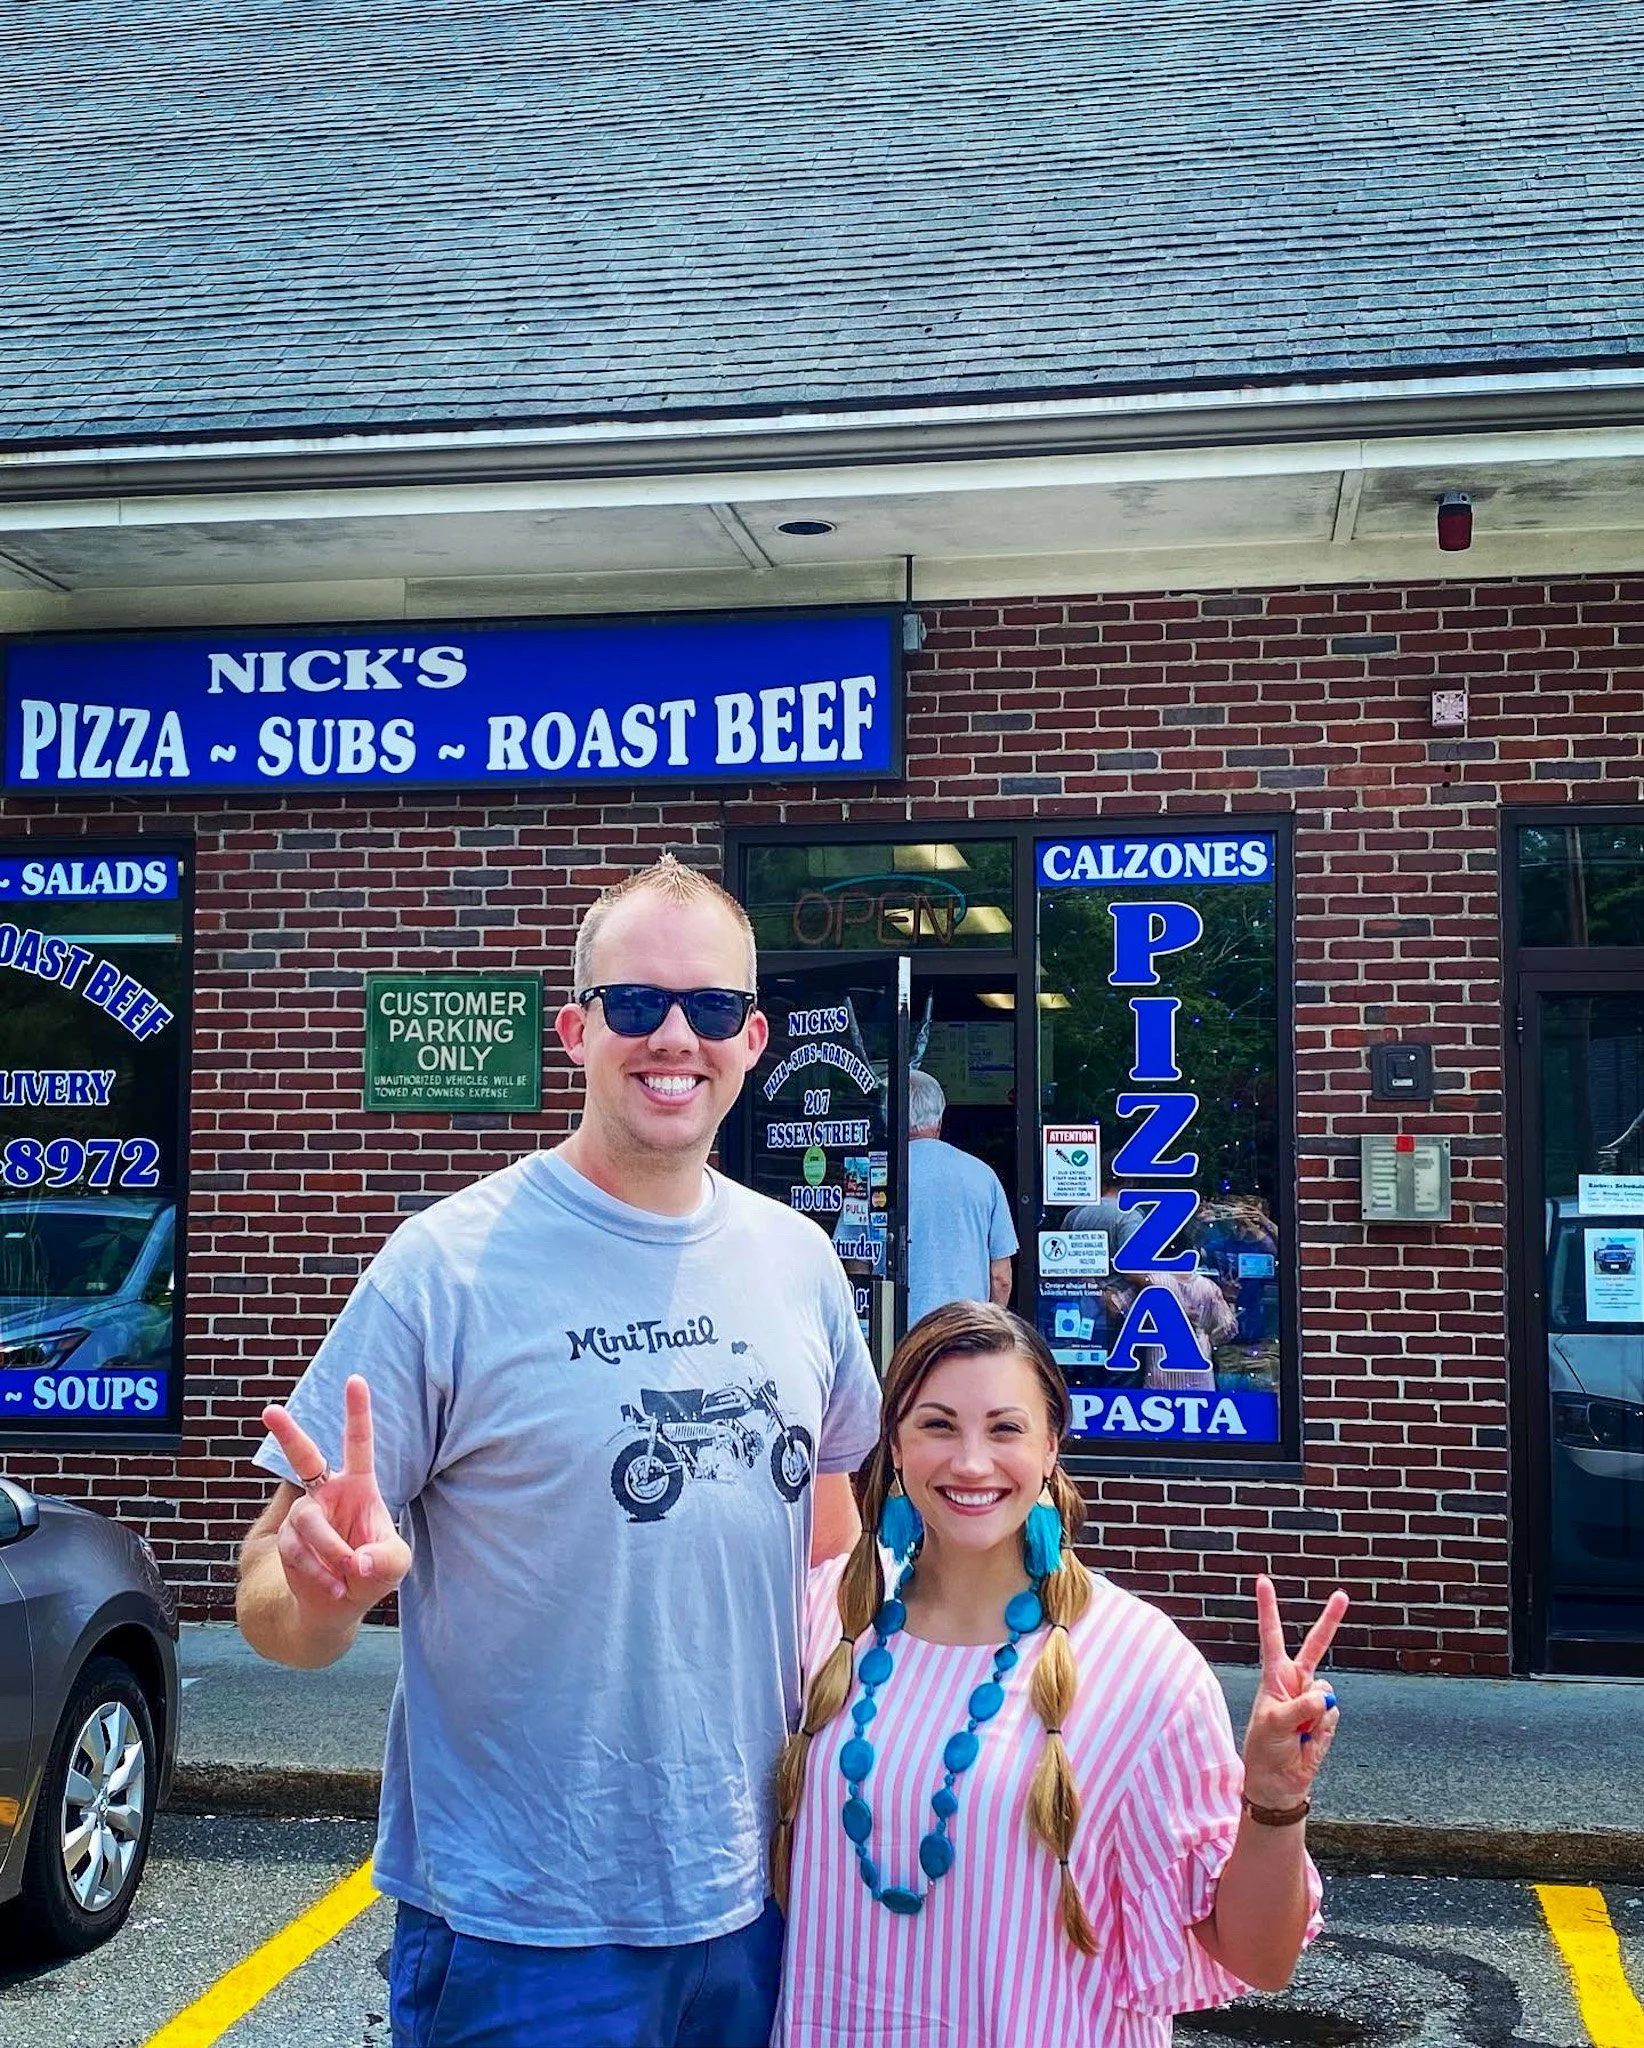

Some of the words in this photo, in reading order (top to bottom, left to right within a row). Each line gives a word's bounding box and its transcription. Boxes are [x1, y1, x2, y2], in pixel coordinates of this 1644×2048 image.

[207, 646, 468, 694] NICK'S
[19, 699, 191, 780] PIZZA
[256, 715, 418, 776] SUBS
[486, 699, 697, 772] ROAST
[715, 675, 877, 765] BEEF
[1042, 841, 1268, 879] CALZONES
[21, 861, 168, 895] SALADS
[792, 891, 956, 946] OPEN
[82, 960, 174, 1042] BEEF
[379, 991, 526, 1016] CUSTOMER
[389, 1018, 514, 1043] PARKING
[788, 1007, 849, 1036] NICK'S
[417, 1045, 493, 1071] ONLY
[374, 1075, 442, 1086] UNAUTHORIZED
[445, 1075, 488, 1086] VEHICLES
[493, 1075, 514, 1086] WILL
[516, 1075, 527, 1086] BE
[375, 1087, 409, 1098] TOWED
[411, 1087, 423, 1097] AT
[426, 1087, 465, 1098] OWNERS
[804, 1088, 831, 1115] 207
[767, 1123, 813, 1149] ESSEX
[813, 1120, 870, 1147] STREET
[1049, 1130, 1094, 1142] ATTENTION
[1105, 901, 1212, 1373] PIZZA
[790, 1186, 843, 1211] HOURS
[845, 1203, 866, 1214] PULL
[872, 1214, 887, 1226] VISA
[32, 1375, 159, 1411] SOUPS
[1070, 1394, 1247, 1434] PASTA
